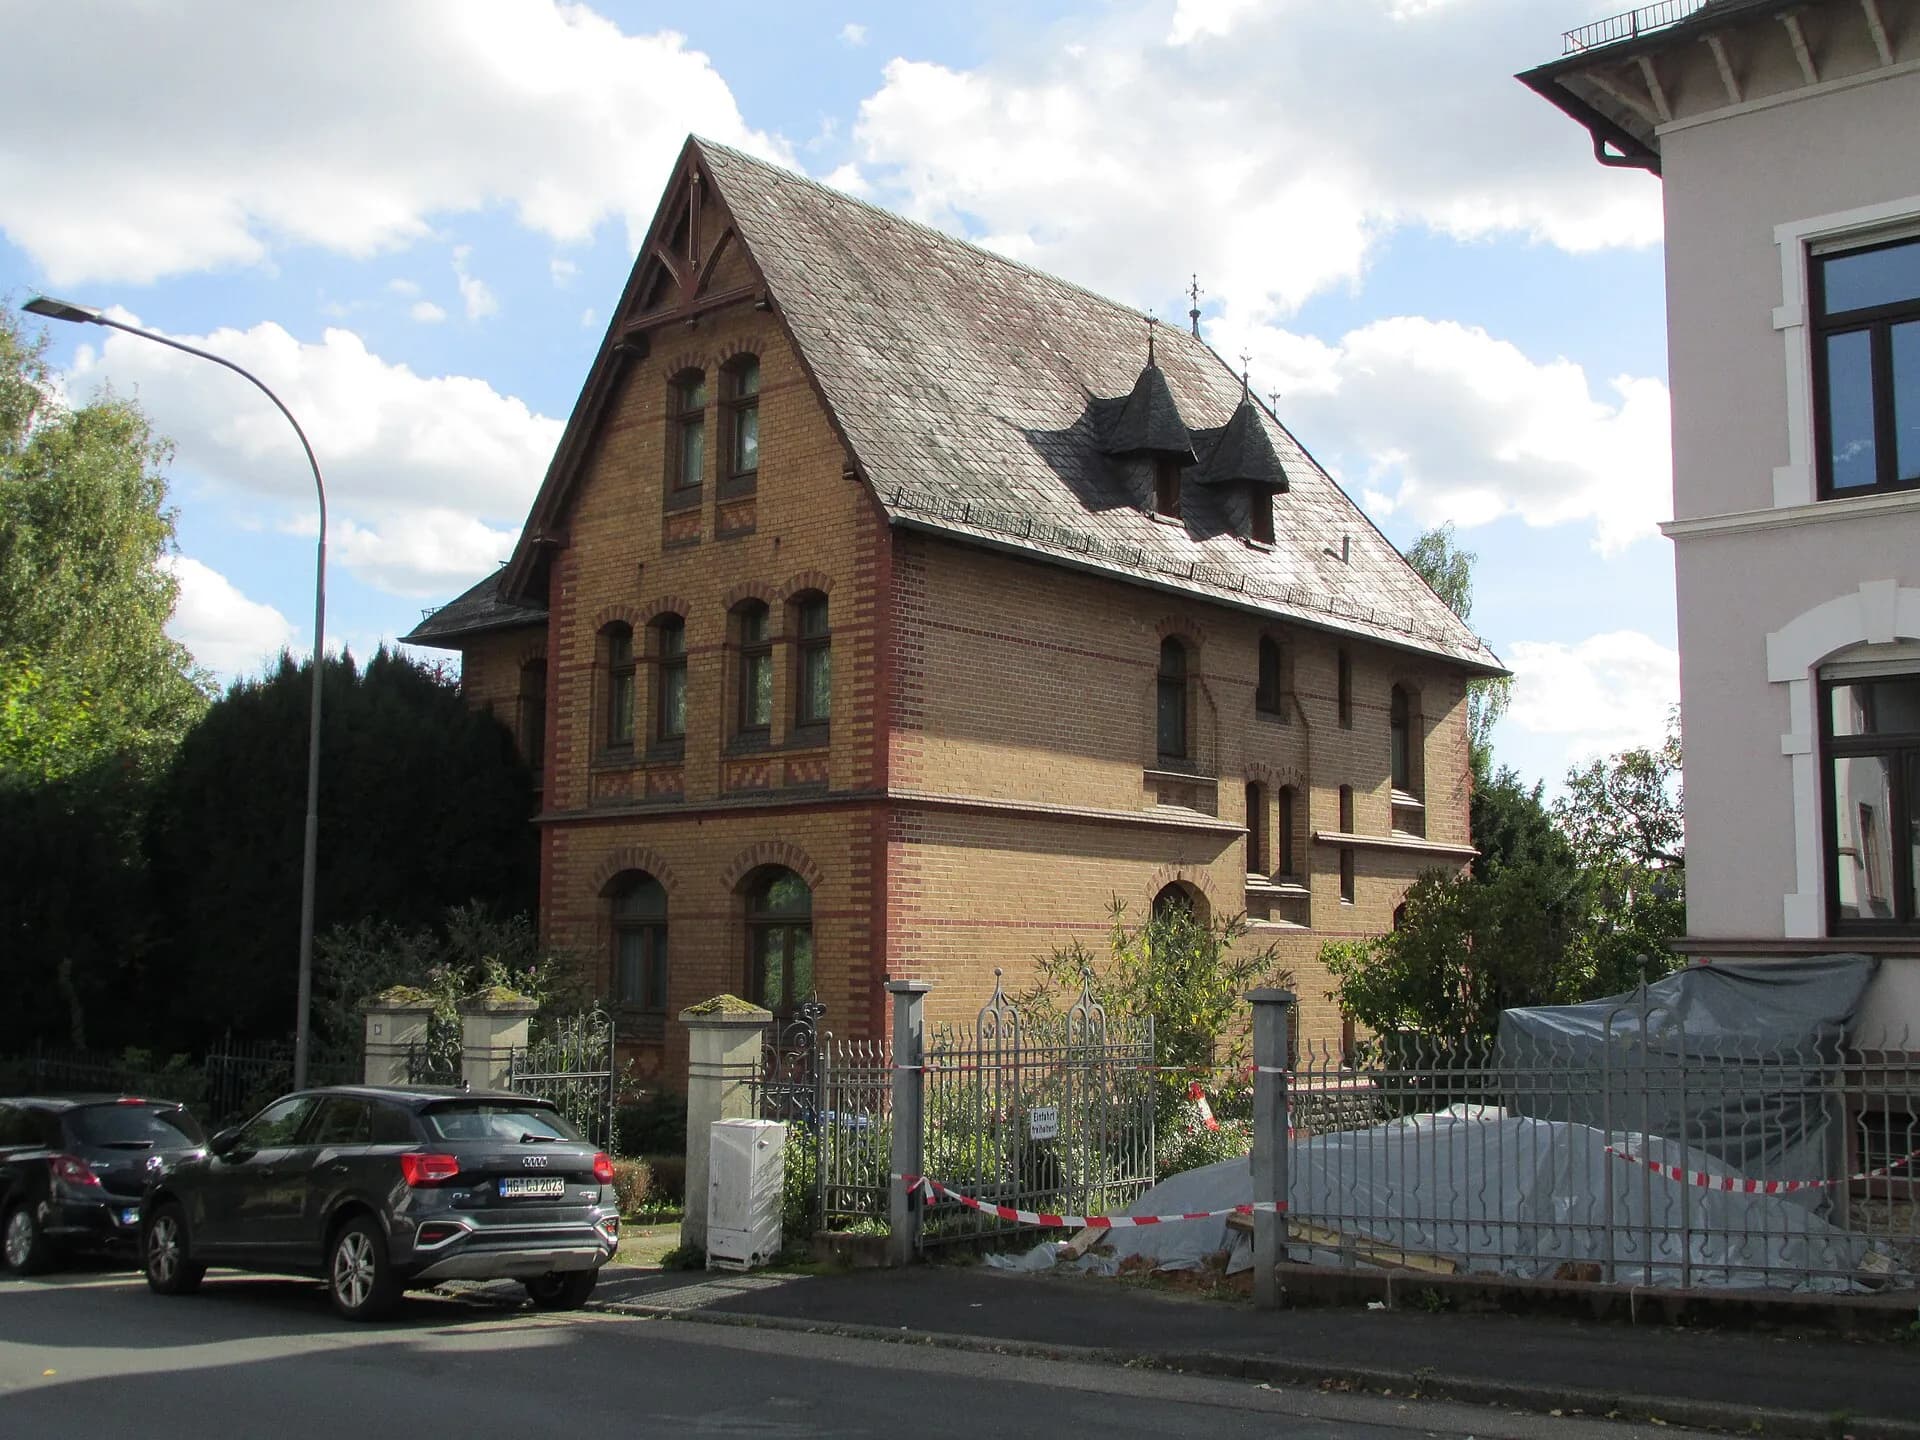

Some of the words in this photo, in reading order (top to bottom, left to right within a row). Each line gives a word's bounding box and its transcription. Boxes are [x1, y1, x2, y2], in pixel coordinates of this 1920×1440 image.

[1033, 1111, 1055, 1122] Einfahrt
[506, 1179, 519, 1193] HG
[540, 1178, 563, 1192] 2023
